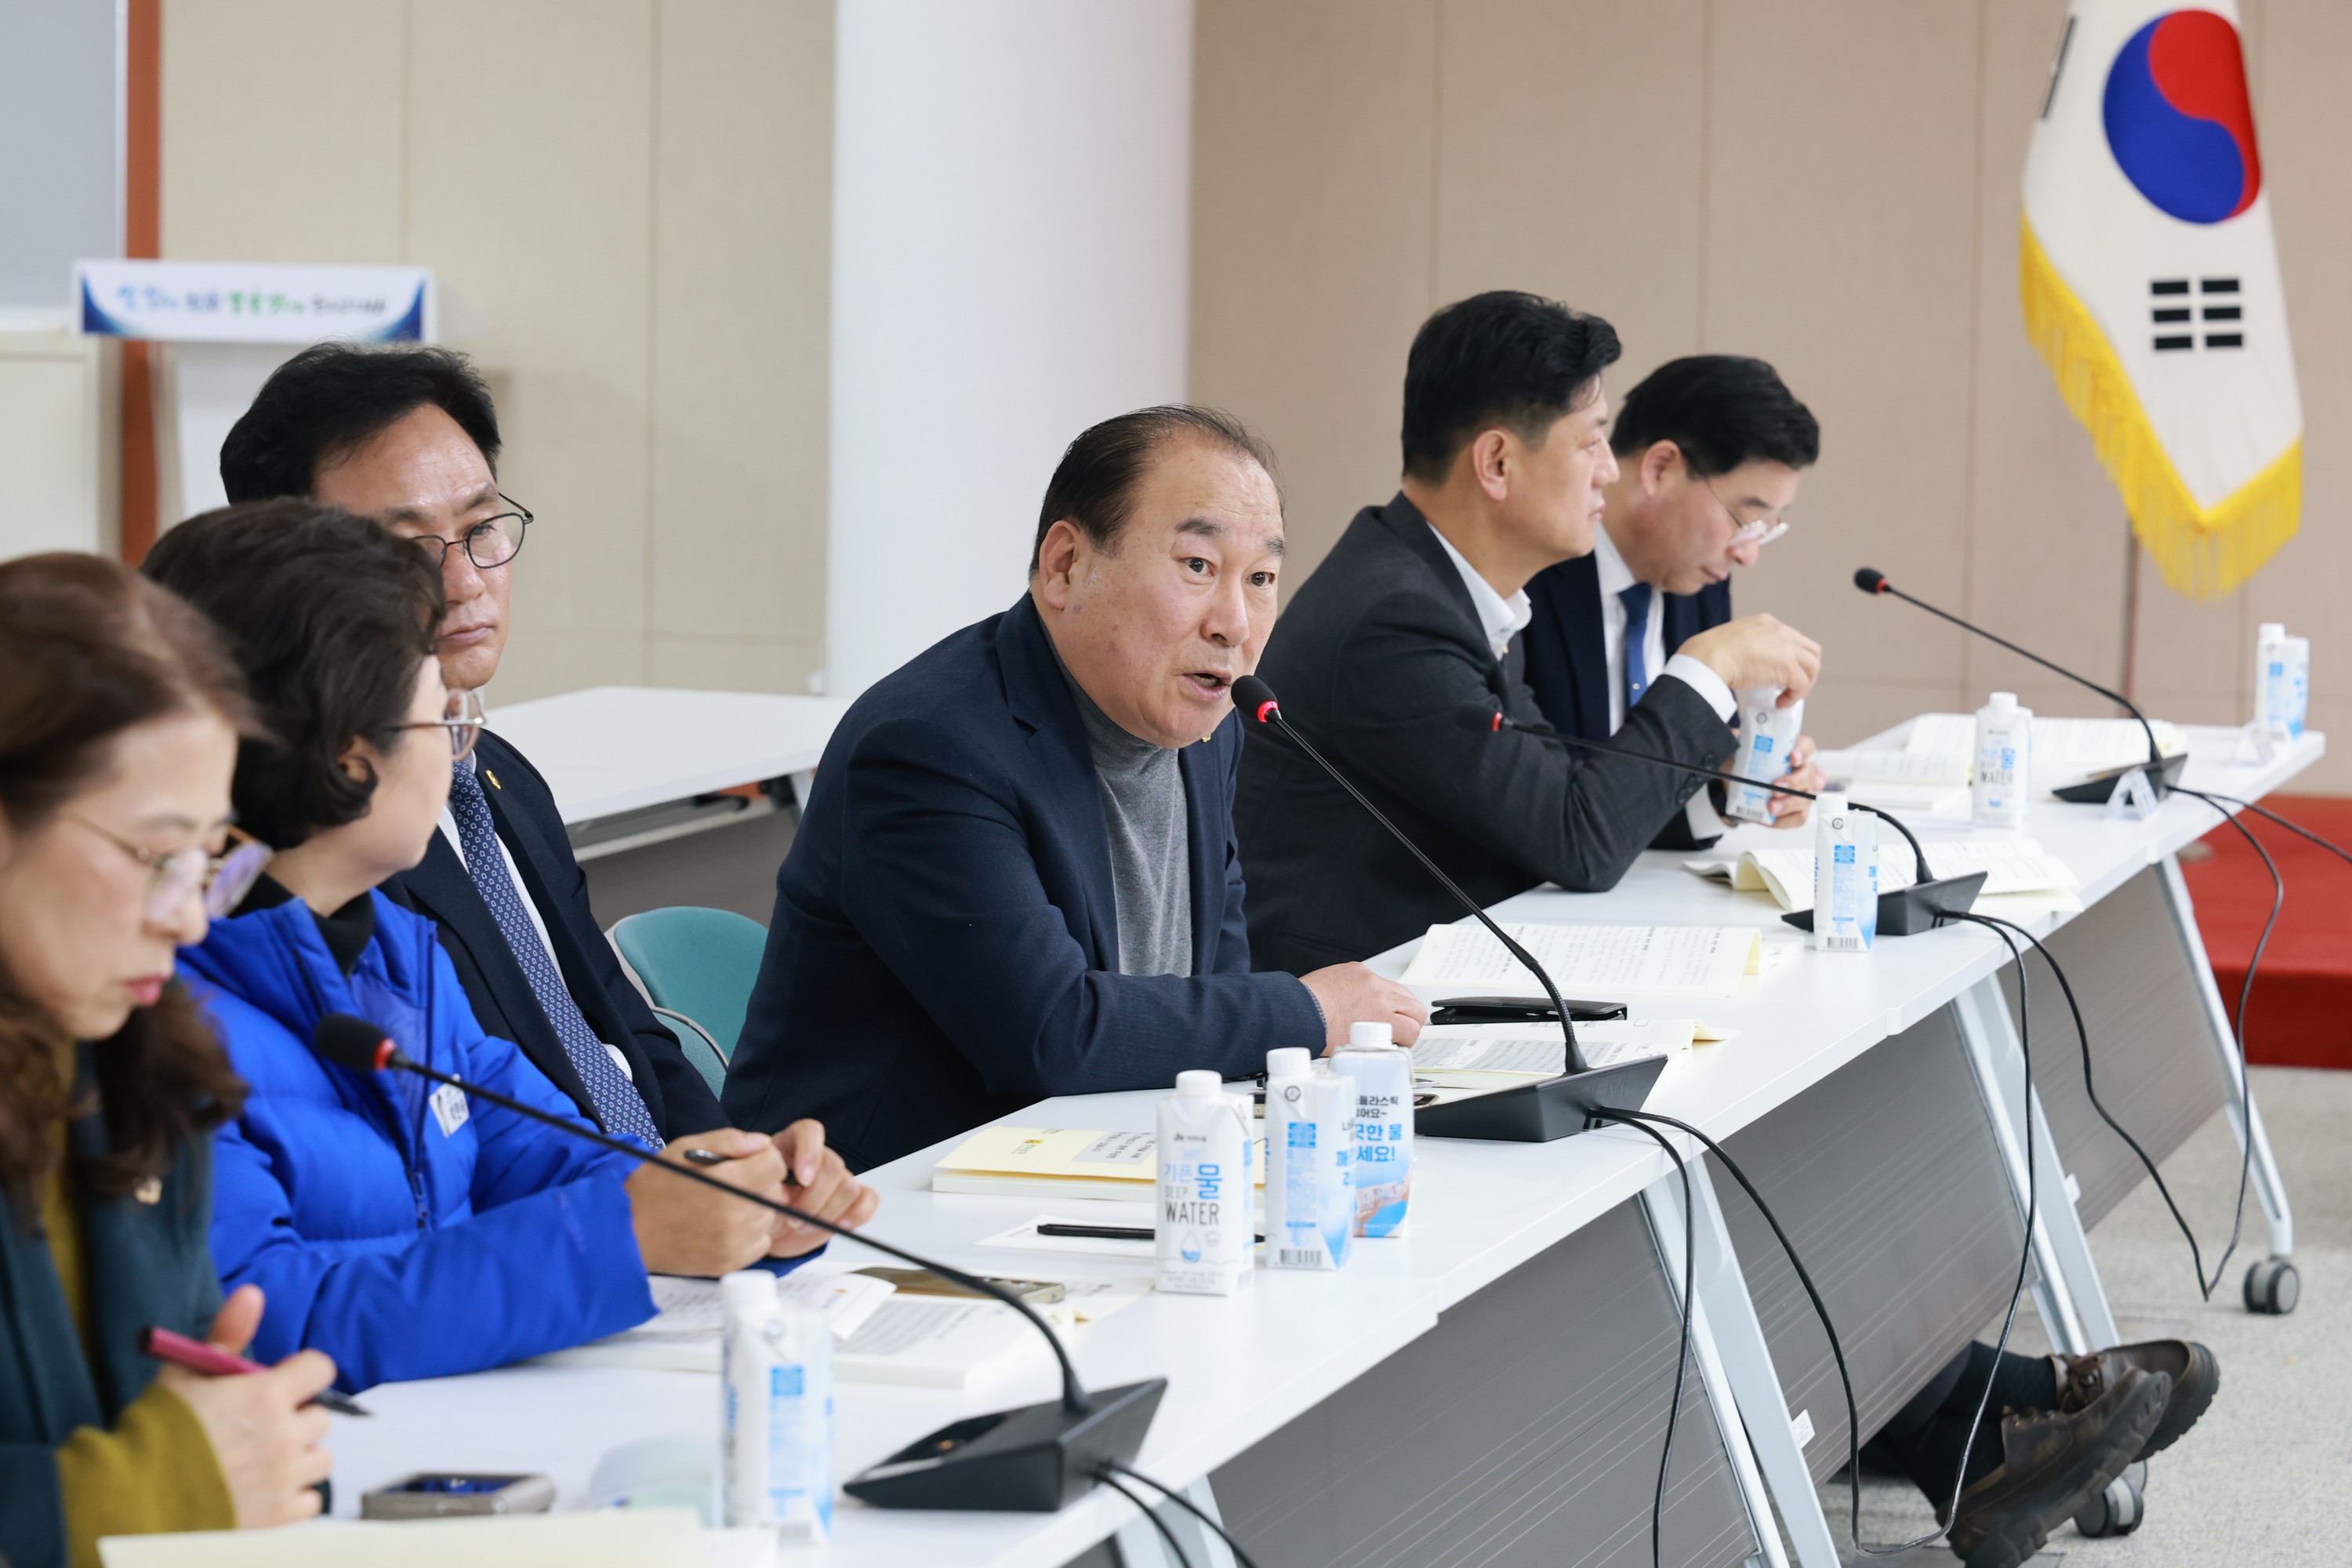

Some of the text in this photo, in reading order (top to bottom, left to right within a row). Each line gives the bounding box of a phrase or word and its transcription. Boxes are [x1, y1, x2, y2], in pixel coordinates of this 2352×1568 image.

[1980, 771, 2013, 786] WATER
[1356, 1094, 1399, 1106] 플라스틱
[1388, 1123, 1402, 1141] 물
[1194, 1163, 1223, 1200] 물
[1165, 1201, 1220, 1225] WATER
